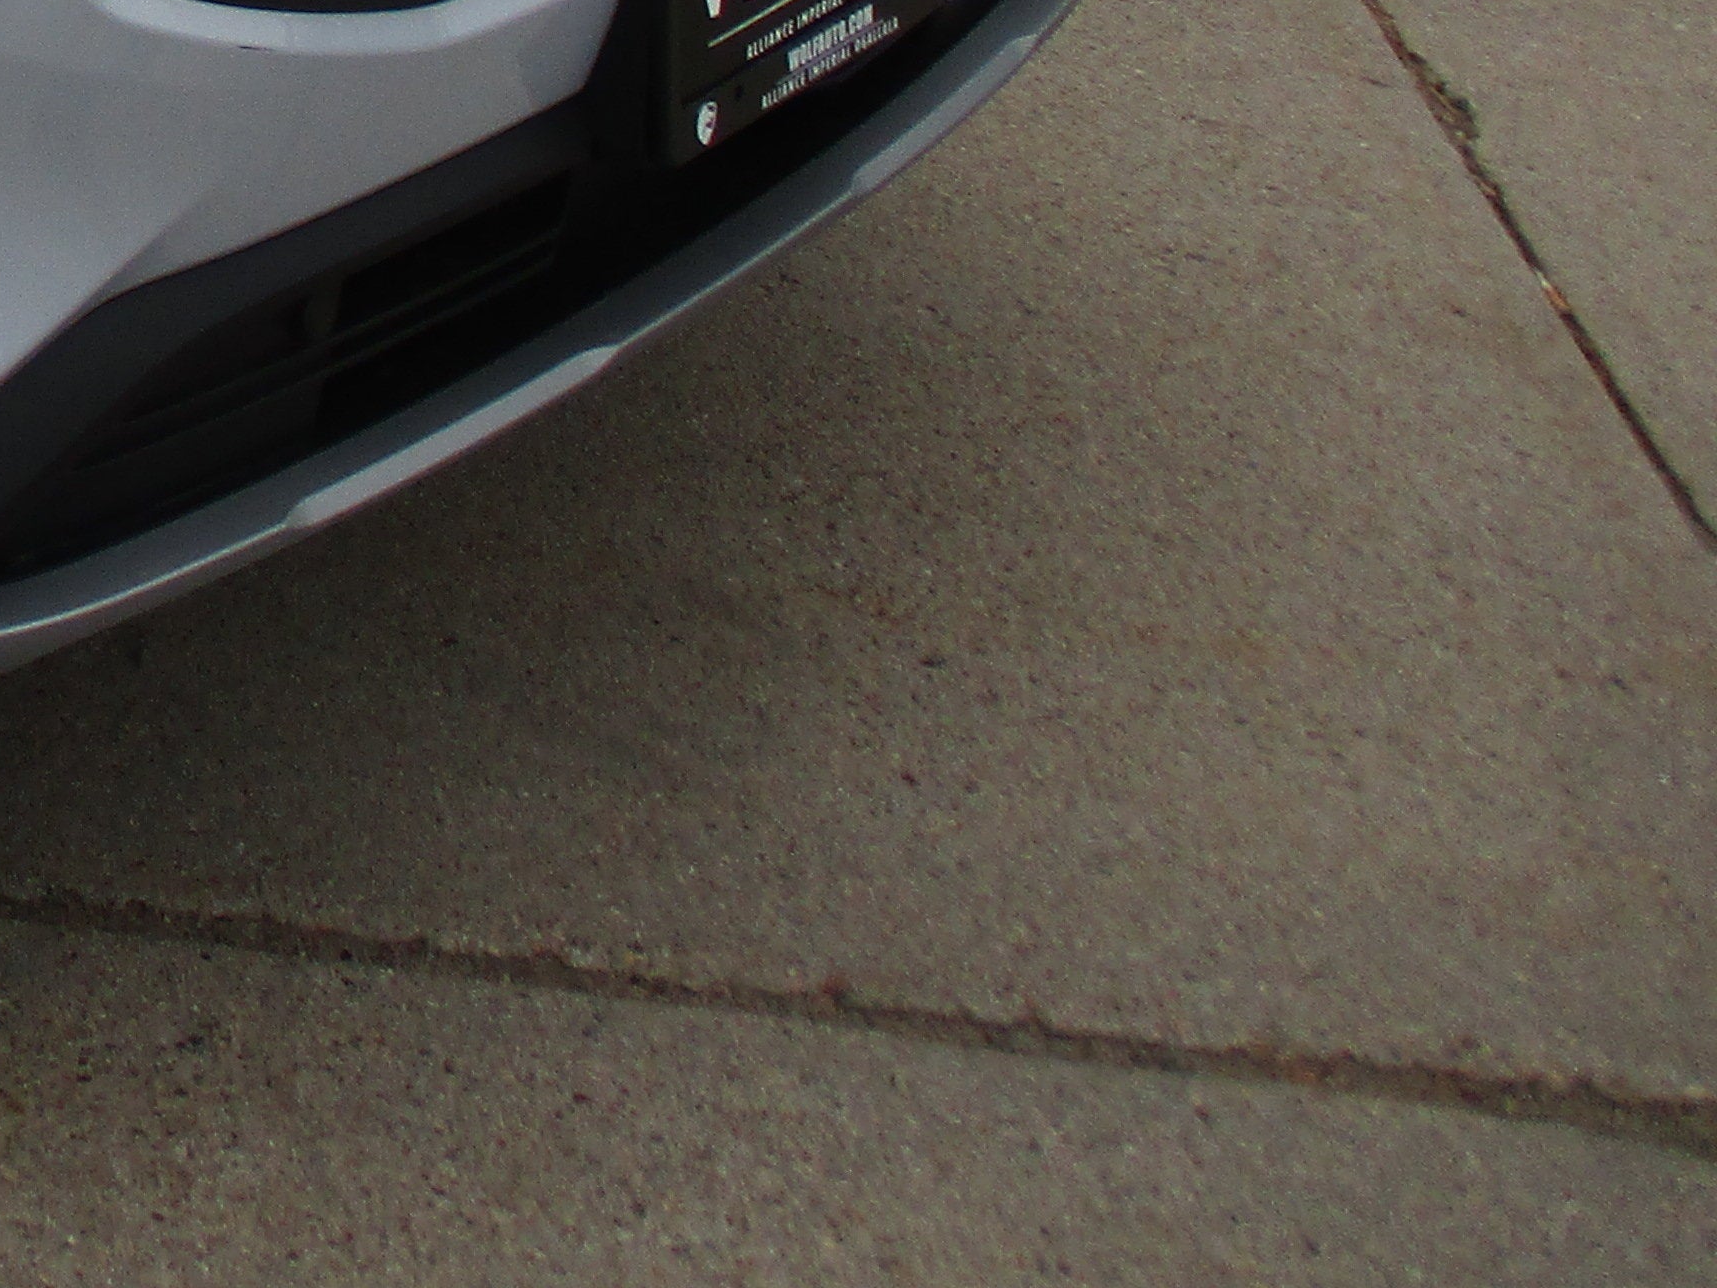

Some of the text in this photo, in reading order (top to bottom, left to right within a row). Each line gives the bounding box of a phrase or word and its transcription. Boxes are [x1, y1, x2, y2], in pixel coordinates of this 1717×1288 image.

[746, 19, 795, 60] ALLIANCE
[787, 3, 874, 72] WOLFAUTO.COM
[761, 72, 805, 110] ALLIANCE
